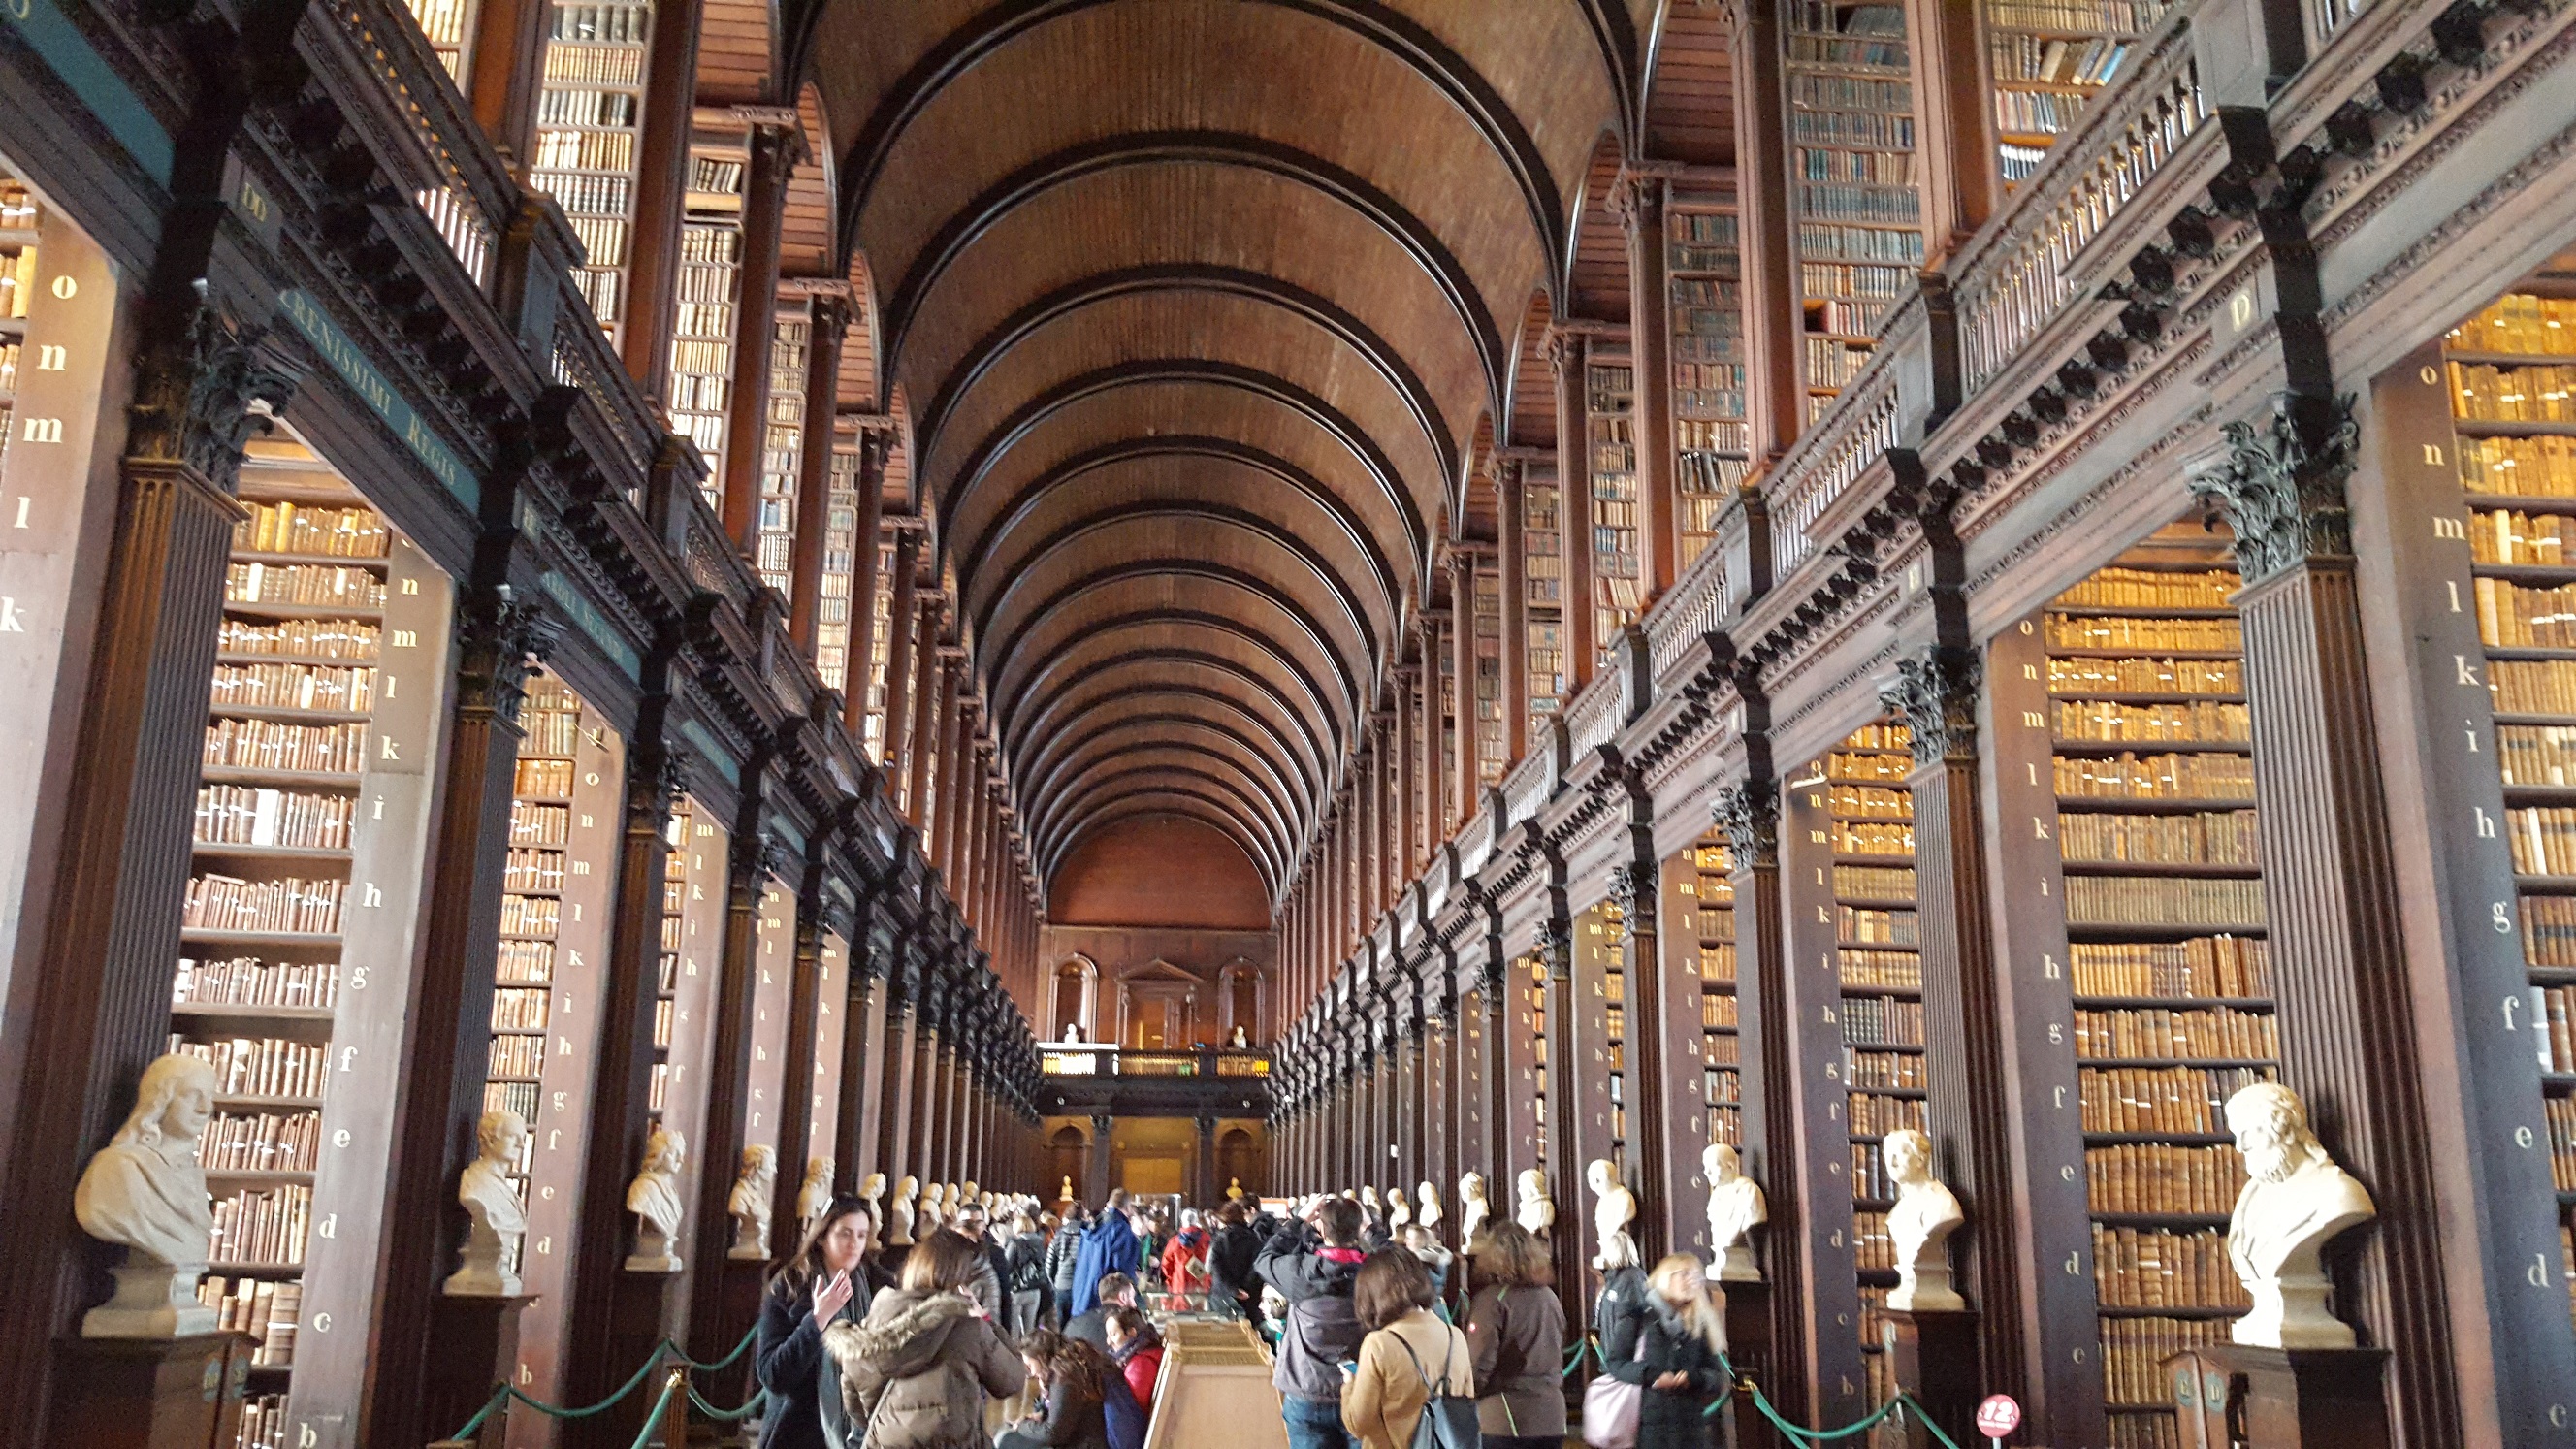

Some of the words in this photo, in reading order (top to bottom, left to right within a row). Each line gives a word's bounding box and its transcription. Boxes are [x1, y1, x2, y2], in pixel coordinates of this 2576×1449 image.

[52, 276, 77, 299] o
[37, 345, 66, 370] n
[2421, 367, 2437, 384] o
[23, 418, 62, 442] m
[407, 411, 455, 486] REGIS
[2423, 444, 2444, 466] n
[14, 497, 30, 528] l
[2433, 518, 2465, 539] m
[402, 579, 418, 595] n
[2447, 581, 2461, 612] l
[0, 596, 24, 632] k
[2020, 621, 2033, 635] o
[392, 630, 416, 647] m
[2024, 664, 2037, 679] n
[2455, 656, 2479, 685] k
[386, 676, 396, 698] l
[2023, 712, 2044, 727] m
[2466, 720, 2478, 752] i
[381, 736, 400, 759] k
[585, 773, 599, 786] o
[2027, 763, 2037, 785] l
[372, 795, 384, 819] i
[1811, 794, 1821, 807] n
[582, 815, 593, 827] n
[2034, 817, 2049, 838] k
[2475, 807, 2496, 838] h
[696, 824, 713, 836] m
[1811, 831, 1826, 843] m
[695, 855, 701, 870] l
[1683, 850, 1691, 860] n
[573, 861, 589, 874] m
[1817, 868, 1822, 885] l
[363, 883, 381, 907] h
[692, 885, 703, 900] k
[1680, 884, 1694, 894] m
[2042, 878, 2048, 895] i
[770, 892, 779, 902] n
[574, 904, 581, 921] l
[1818, 906, 1830, 923] k
[2493, 901, 2510, 933] g
[691, 919, 695, 935] i
[768, 918, 780, 928] m
[1590, 924, 1601, 934] m
[1684, 915, 1690, 929] l
[767, 941, 772, 954] l
[569, 950, 584, 966] k
[686, 958, 696, 975] h
[1518, 958, 1530, 968] m
[1686, 958, 1696, 974] k
[1822, 953, 1828, 968] i
[2044, 954, 2060, 979] h
[350, 966, 370, 989] g
[763, 970, 771, 983] k
[1594, 982, 1603, 996] k
[564, 993, 571, 1013] i
[1823, 1006, 1836, 1023] h
[2503, 996, 2519, 1030] f
[559, 1037, 571, 1054] h
[757, 1046, 765, 1060] h
[1689, 1039, 1698, 1054] h
[339, 1046, 358, 1071] f
[554, 1092, 567, 1111] g
[2055, 1086, 2065, 1108] f
[333, 1129, 350, 1147] e
[549, 1129, 561, 1149] f
[2515, 1127, 2532, 1148] e
[1830, 1163, 1840, 1174] e
[2062, 1166, 2075, 1181] e
[541, 1186, 554, 1199] e
[319, 1213, 337, 1238] d
[537, 1237, 550, 1254] d
[1694, 1230, 1703, 1245] d
[1831, 1229, 1842, 1247] d
[2066, 1251, 2079, 1275] d
[2528, 1254, 2550, 1287] d
[314, 1313, 331, 1332] c
[521, 1364, 531, 1384] b
[1984, 1401, 2013, 1423] 12
[2550, 1404, 2566, 1427] c
[299, 1423, 316, 1448] b
